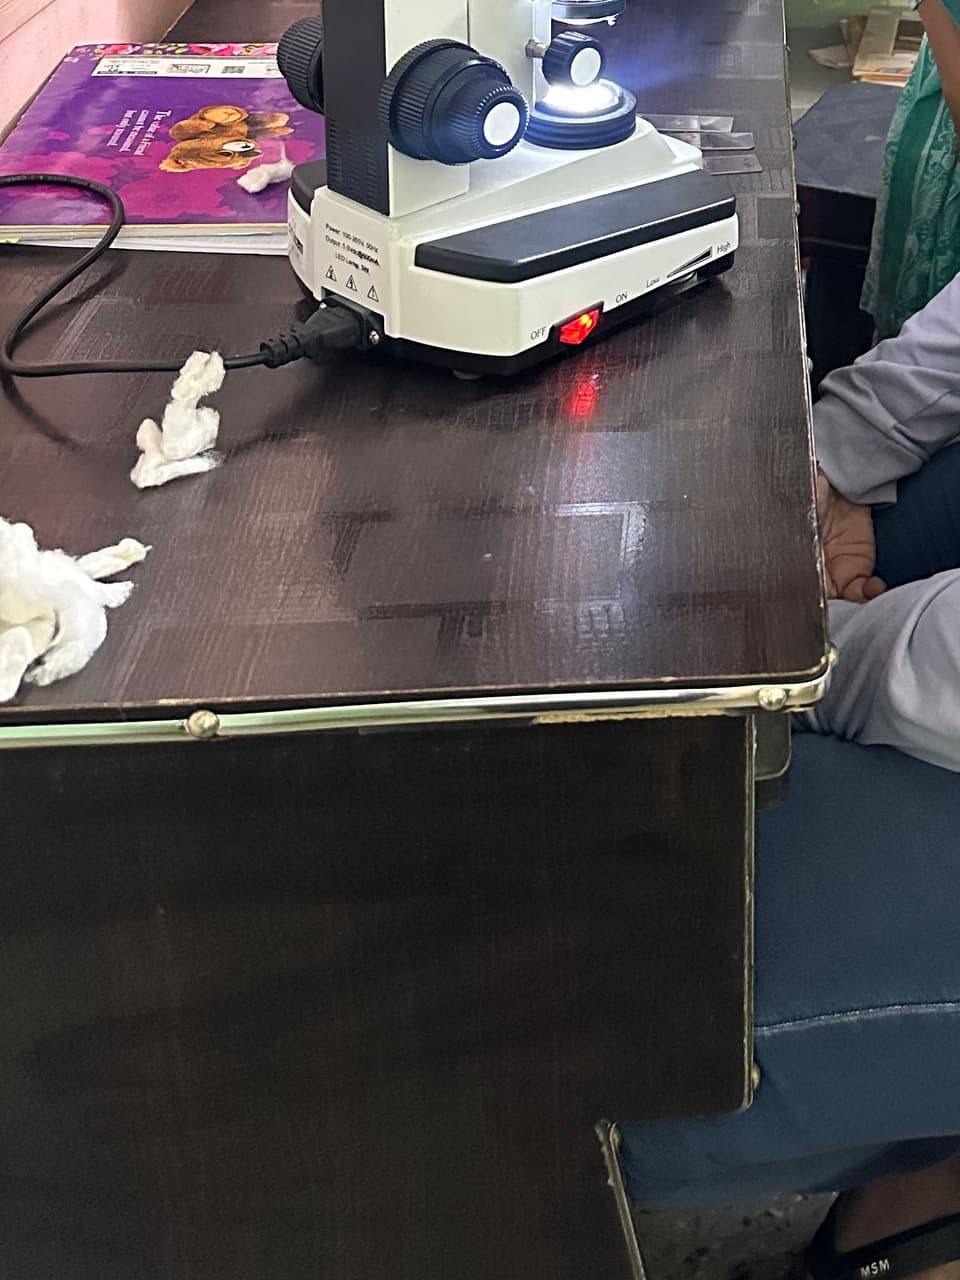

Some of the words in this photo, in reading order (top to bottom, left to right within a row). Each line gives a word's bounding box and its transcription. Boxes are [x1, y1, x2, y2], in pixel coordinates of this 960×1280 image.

[716, 241, 731, 254] High
[646, 276, 660, 288] Low
[615, 291, 628, 304] ON
[530, 326, 547, 340] OFF
[860, 1258, 890, 1278] MSM
